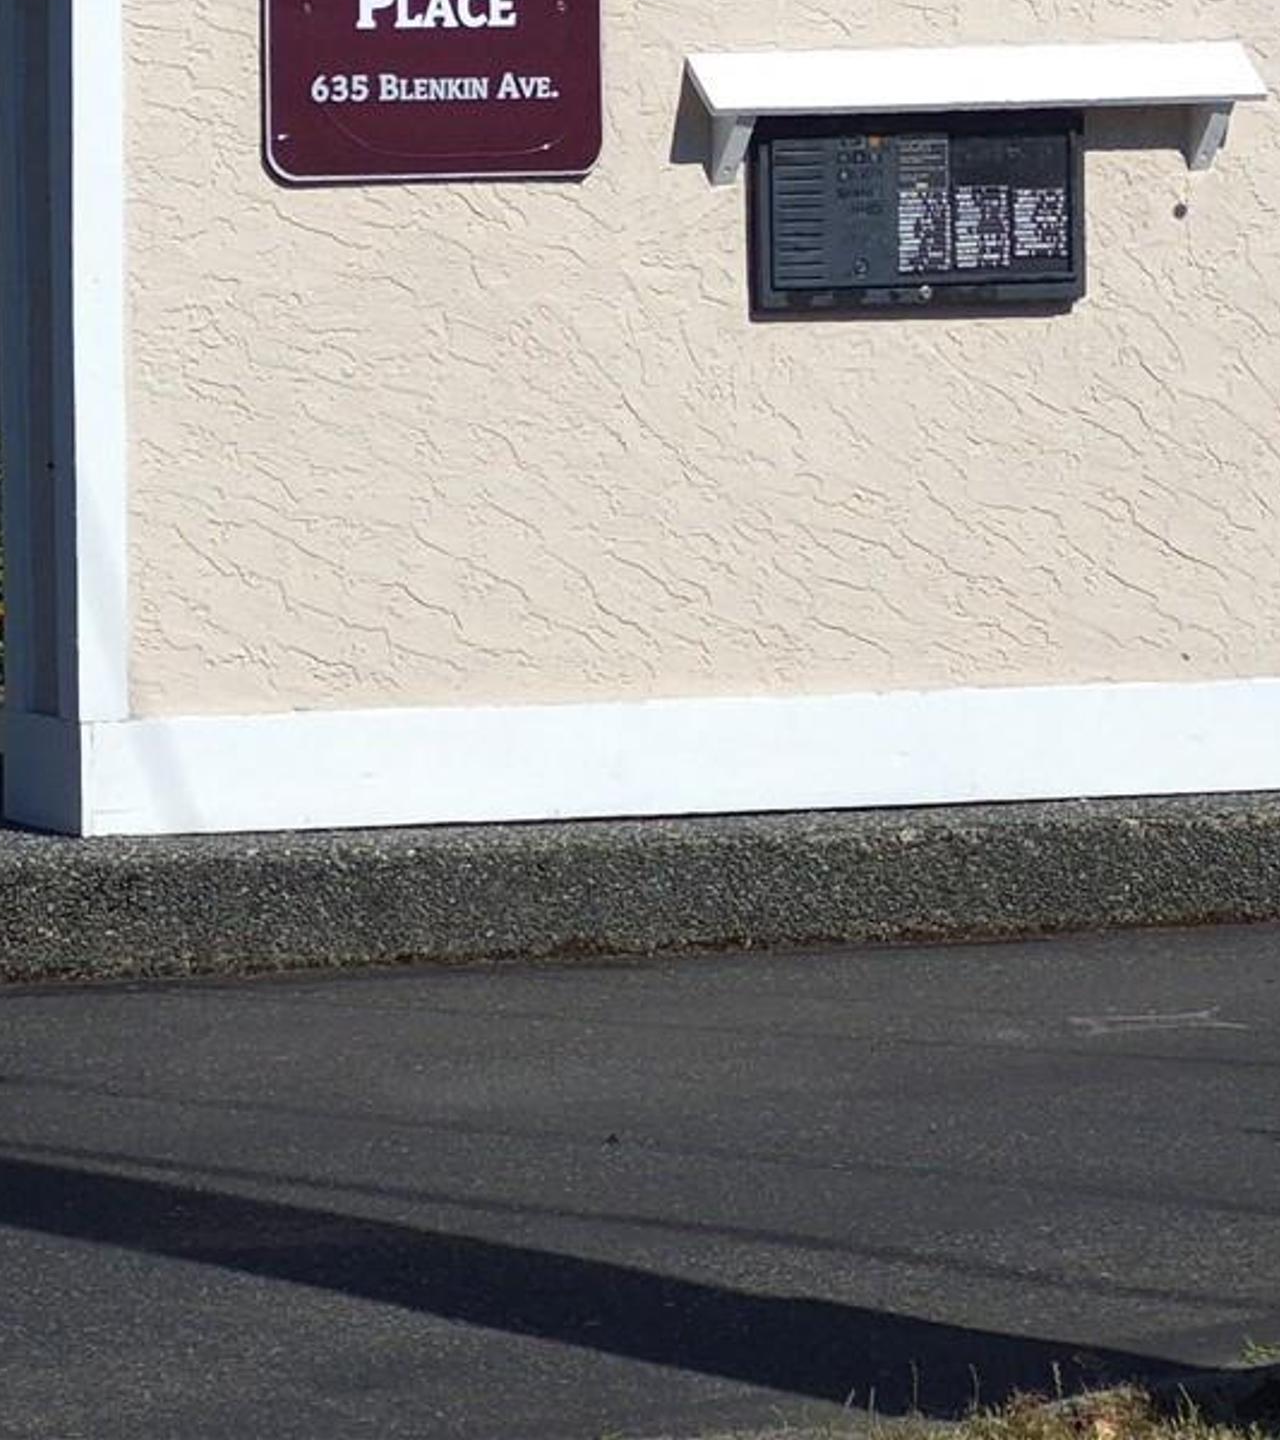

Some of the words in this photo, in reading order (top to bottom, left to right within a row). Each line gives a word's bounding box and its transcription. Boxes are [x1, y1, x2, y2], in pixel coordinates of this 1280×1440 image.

[310, 74, 370, 103] 635
[378, 73, 489, 102] BLENKIN
[496, 71, 560, 100] AVE.
